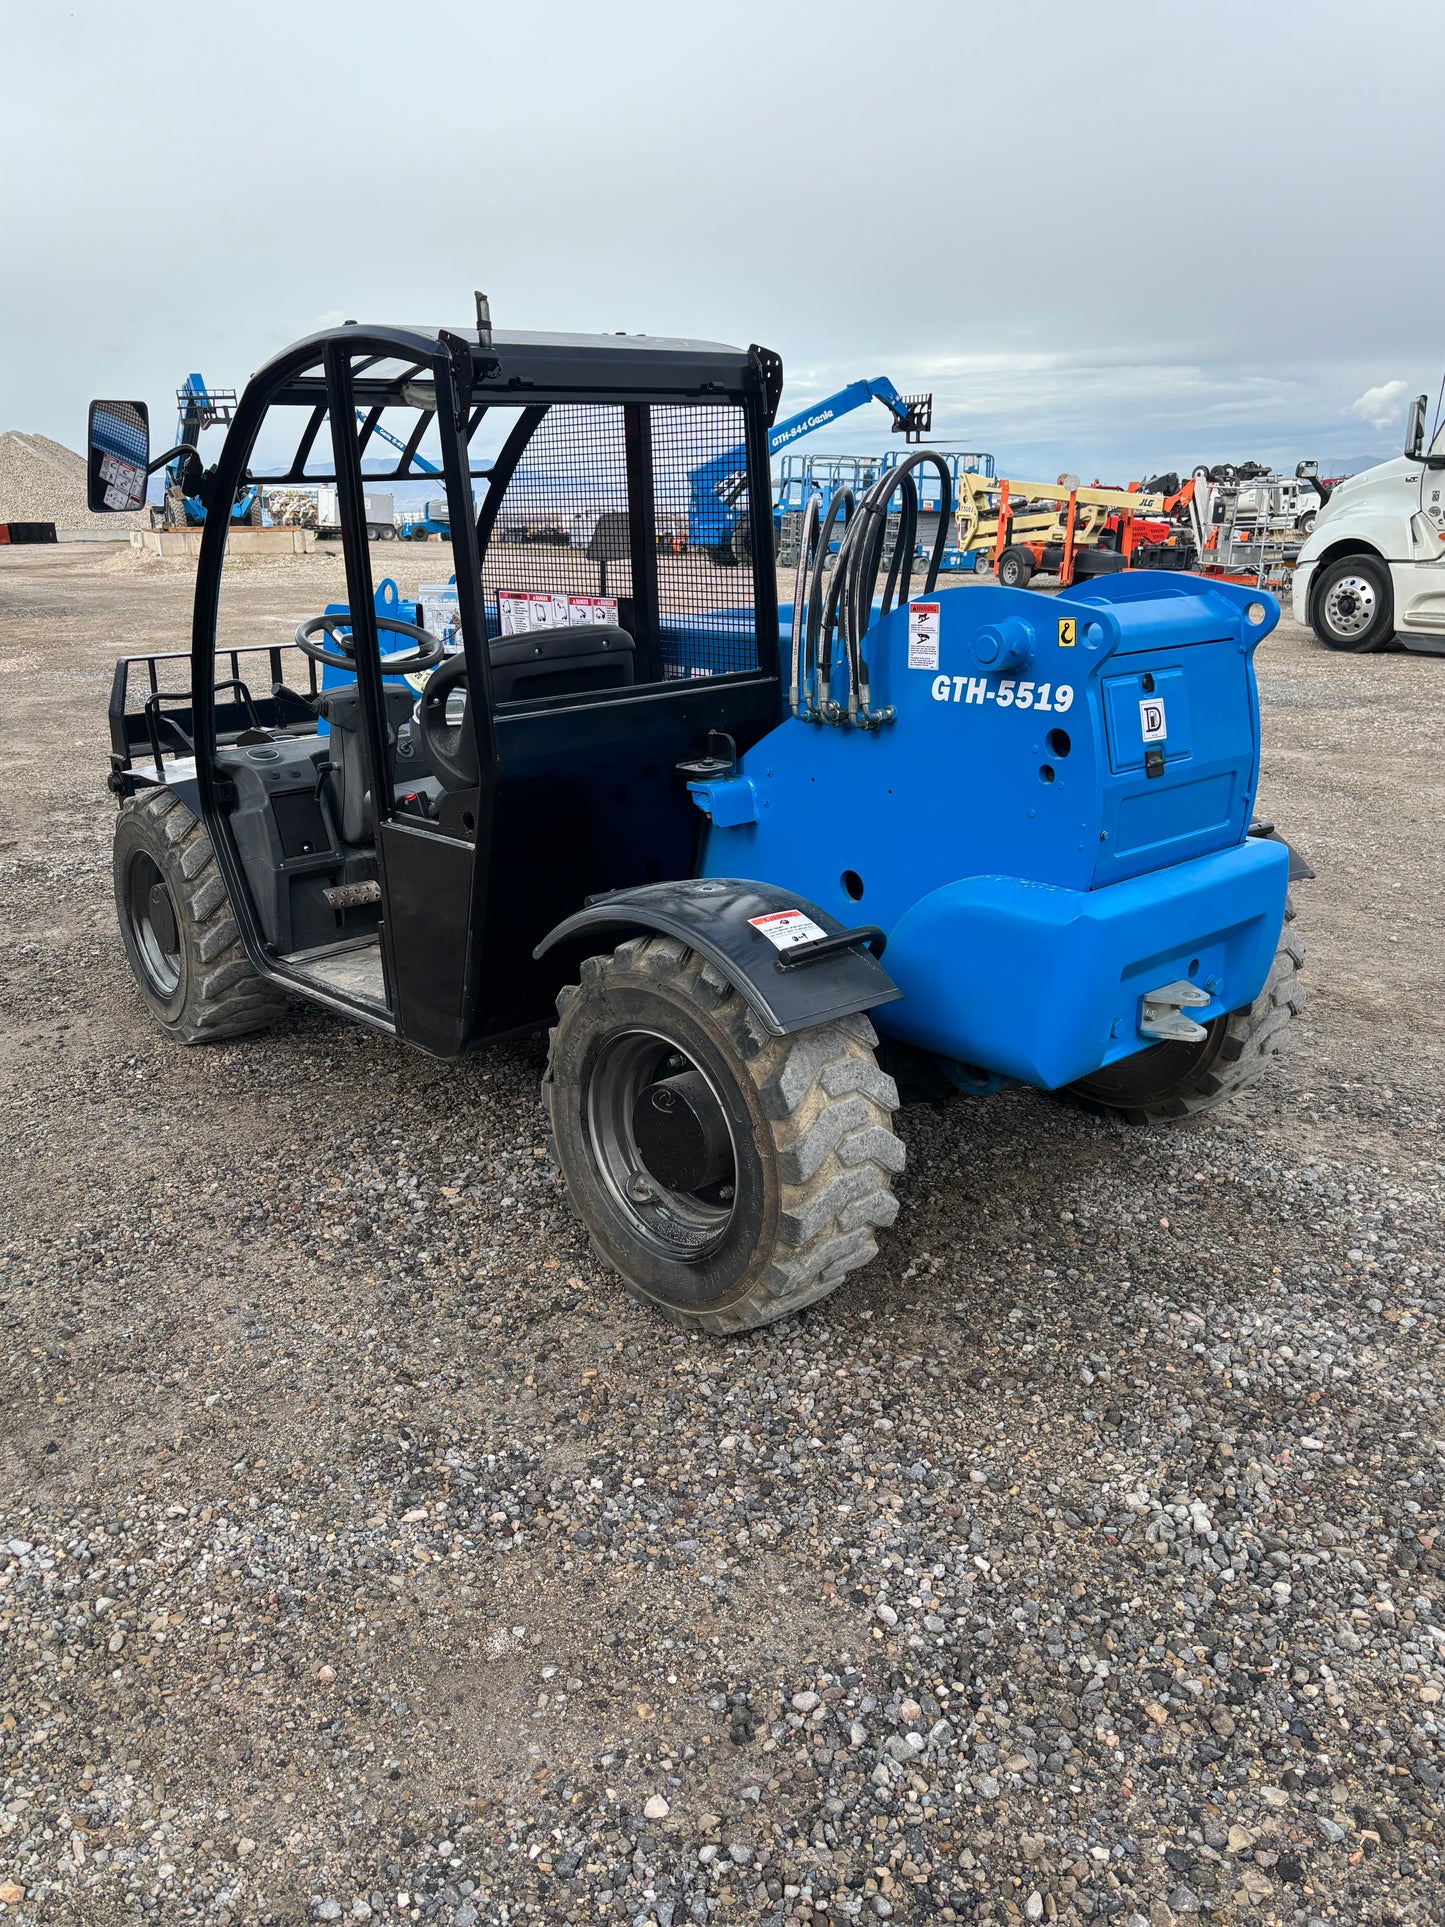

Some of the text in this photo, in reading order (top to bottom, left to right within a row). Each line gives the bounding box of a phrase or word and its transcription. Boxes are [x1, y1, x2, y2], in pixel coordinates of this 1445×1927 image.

[772, 410, 834, 447] GTH-844 Genie
[1138, 498, 1155, 508] JLG
[916, 604, 937, 612] WARNING
[931, 674, 1074, 713] GTH-5519
